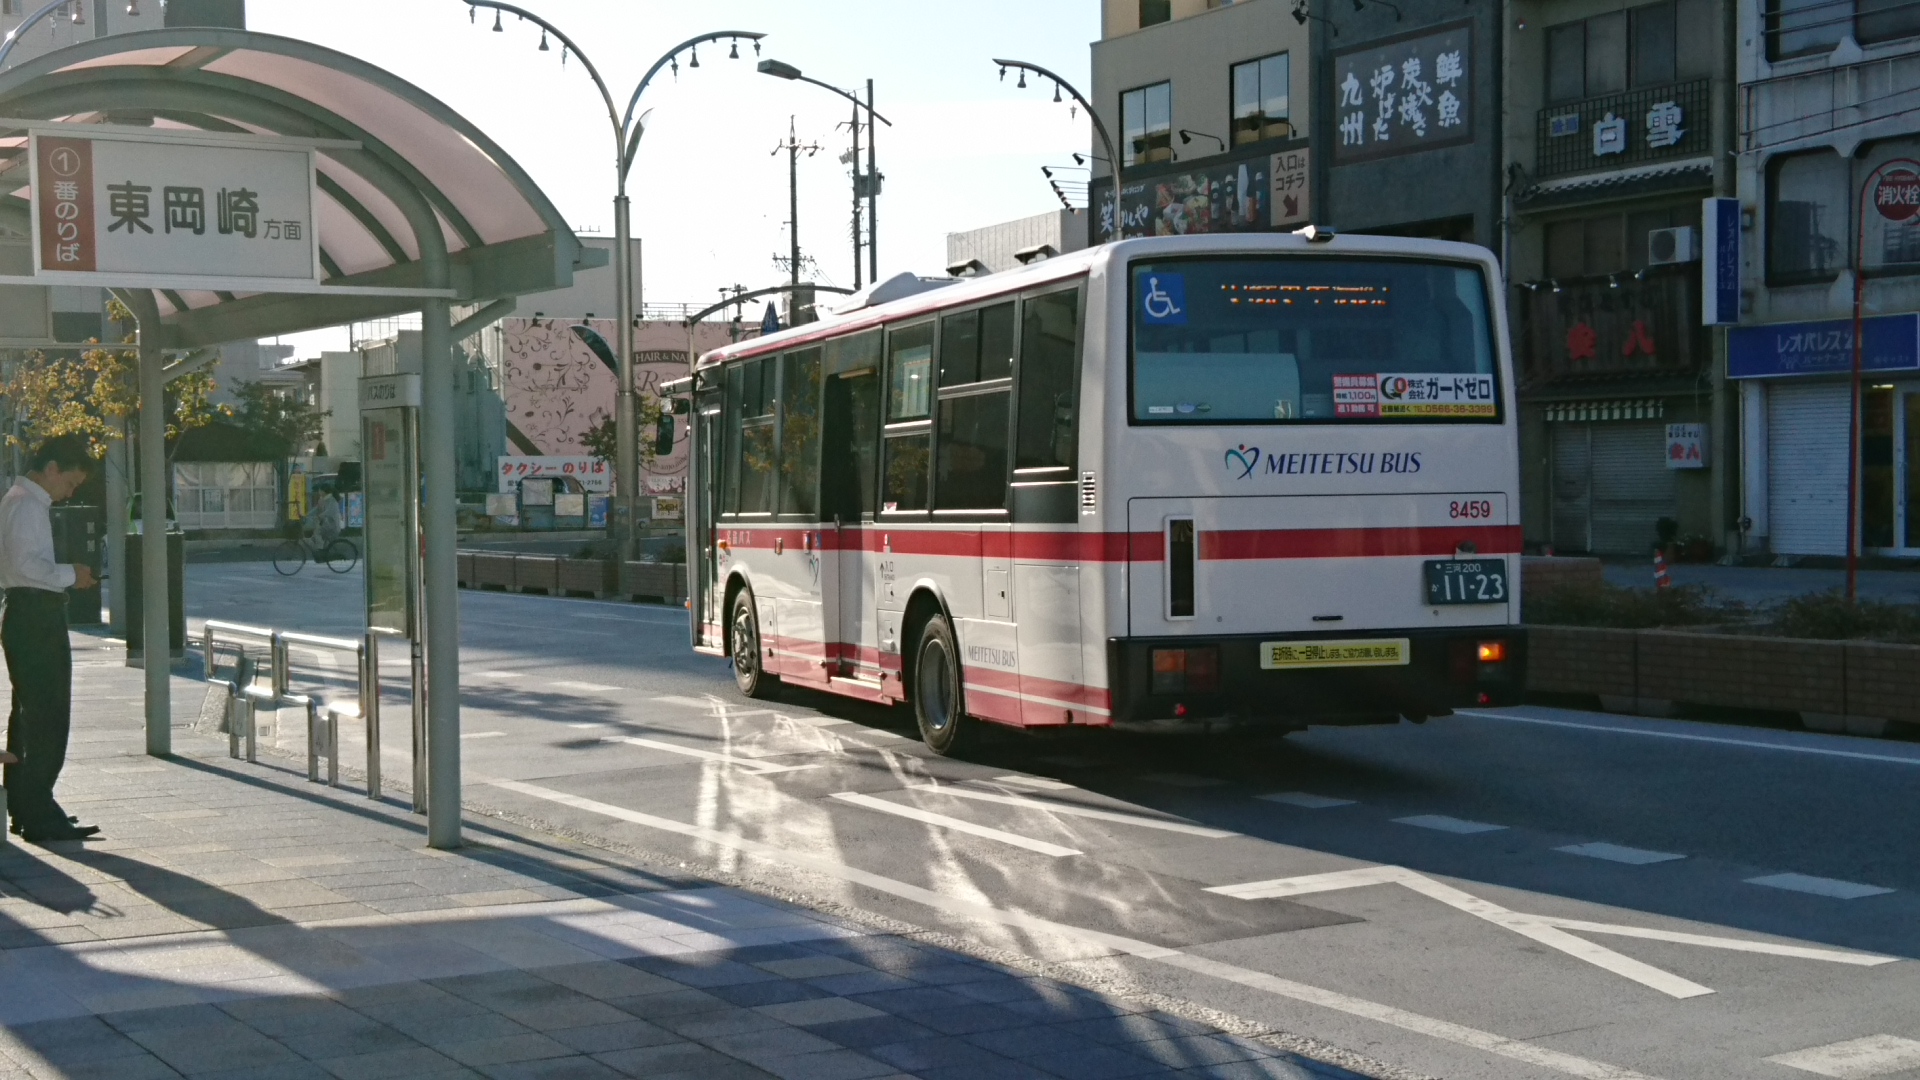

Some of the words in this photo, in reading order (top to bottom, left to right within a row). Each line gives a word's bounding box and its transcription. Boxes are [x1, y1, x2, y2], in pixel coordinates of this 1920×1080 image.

[1436, 50, 1463, 128] 鮮魚
[1339, 72, 1363, 146] 九州
[1369, 64, 1396, 141] 炉ばた
[1593, 100, 1687, 157] 白雪
[1275, 154, 1306, 174] 入口は
[1275, 172, 1306, 191] コチラ
[1878, 185, 1920, 205] 消火栓
[106, 180, 260, 239] 東岡崎
[263, 218, 302, 241] 方面
[635, 351, 661, 363] HAIR
[1407, 379, 1424, 389] 株式
[1408, 389, 1426, 400] 会社
[1426, 378, 1490, 400] ガードゼロ
[1265, 452, 1375, 476] MEITETSU
[1380, 451, 1422, 475] BUS
[1449, 500, 1491, 519] 8459
[1462, 563, 1482, 573] 200
[1444, 573, 1504, 600] 11-23
[968, 645, 1001, 666] MEITETSU
[1002, 649, 1016, 668] BUS
